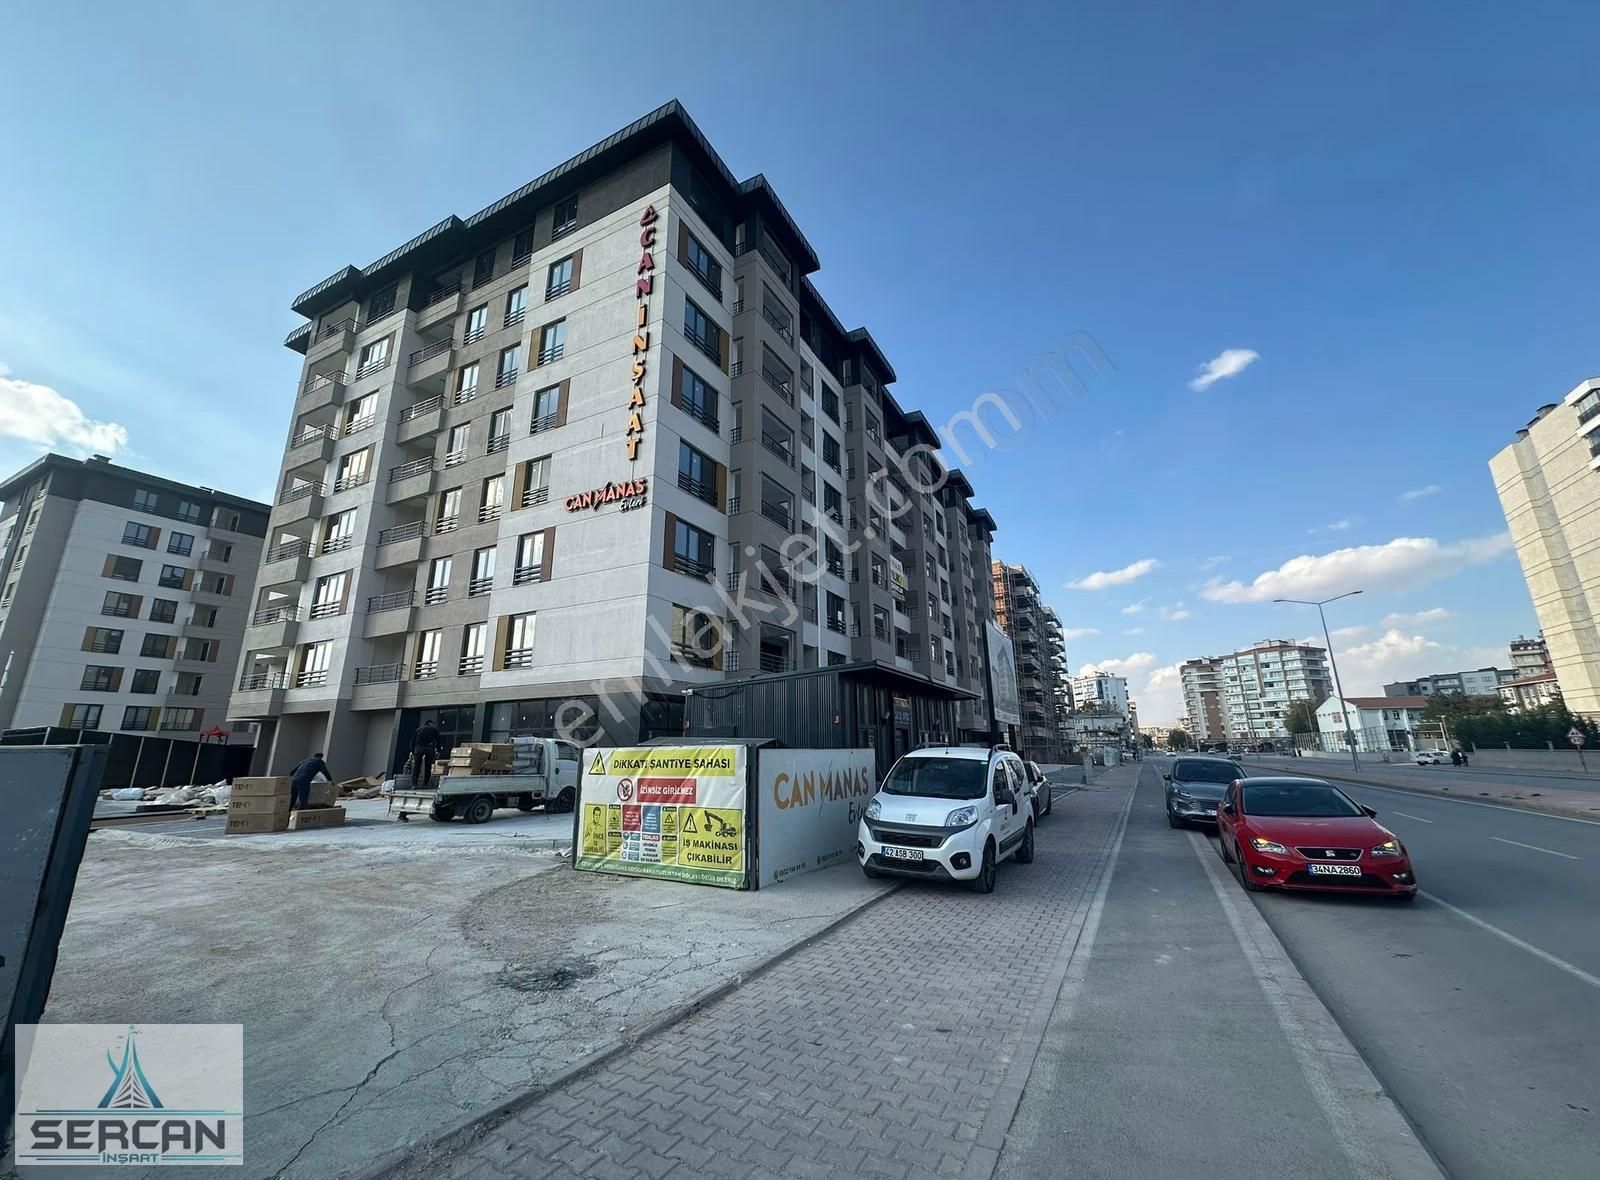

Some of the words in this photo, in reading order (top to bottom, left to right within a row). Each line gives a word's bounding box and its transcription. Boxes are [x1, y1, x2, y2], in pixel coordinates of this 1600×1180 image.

[636, 227, 657, 300] CAN
[563, 491, 593, 513] CAN
[593, 478, 648, 508] MANAS
[650, 758, 691, 770] ŞANTİYE
[693, 758, 730, 769] SAHASI
[774, 772, 815, 810] CAN
[819, 766, 869, 802] MANAS
[683, 837, 691, 848] İŞ
[692, 839, 738, 851] MAKİNASI
[686, 852, 733, 864] ÇIKABİLİR
[908, 850, 922, 860] 300
